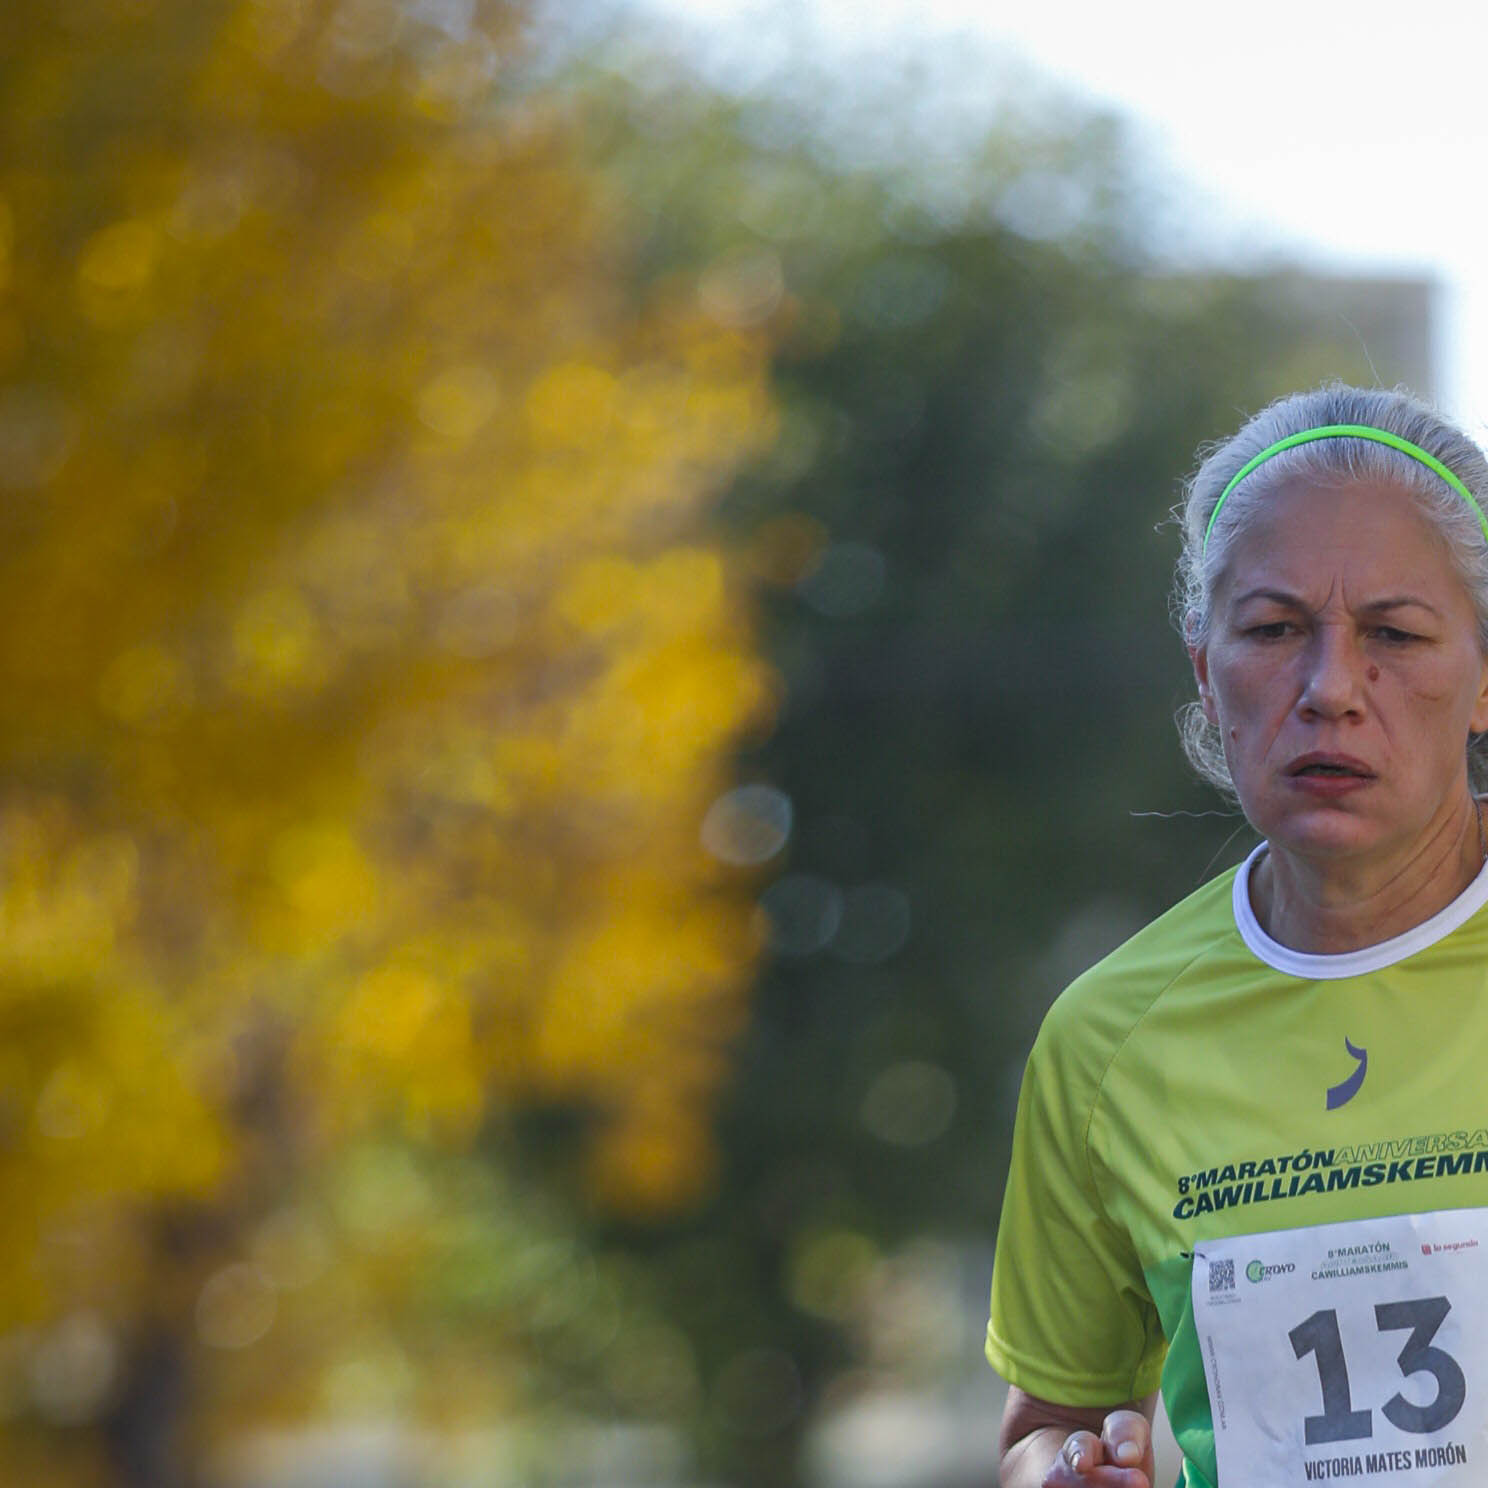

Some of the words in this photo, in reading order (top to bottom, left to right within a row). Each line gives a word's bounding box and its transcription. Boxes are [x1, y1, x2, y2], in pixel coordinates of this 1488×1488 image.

[1311, 1260, 1409, 1281] CAWILLIAMSKEMMIS
[1288, 1296, 1466, 1445] 13
[1304, 1456, 1363, 1481] VICTORIA
[1366, 1450, 1412, 1474] MATES
[1415, 1441, 1467, 1468] MORÓN
